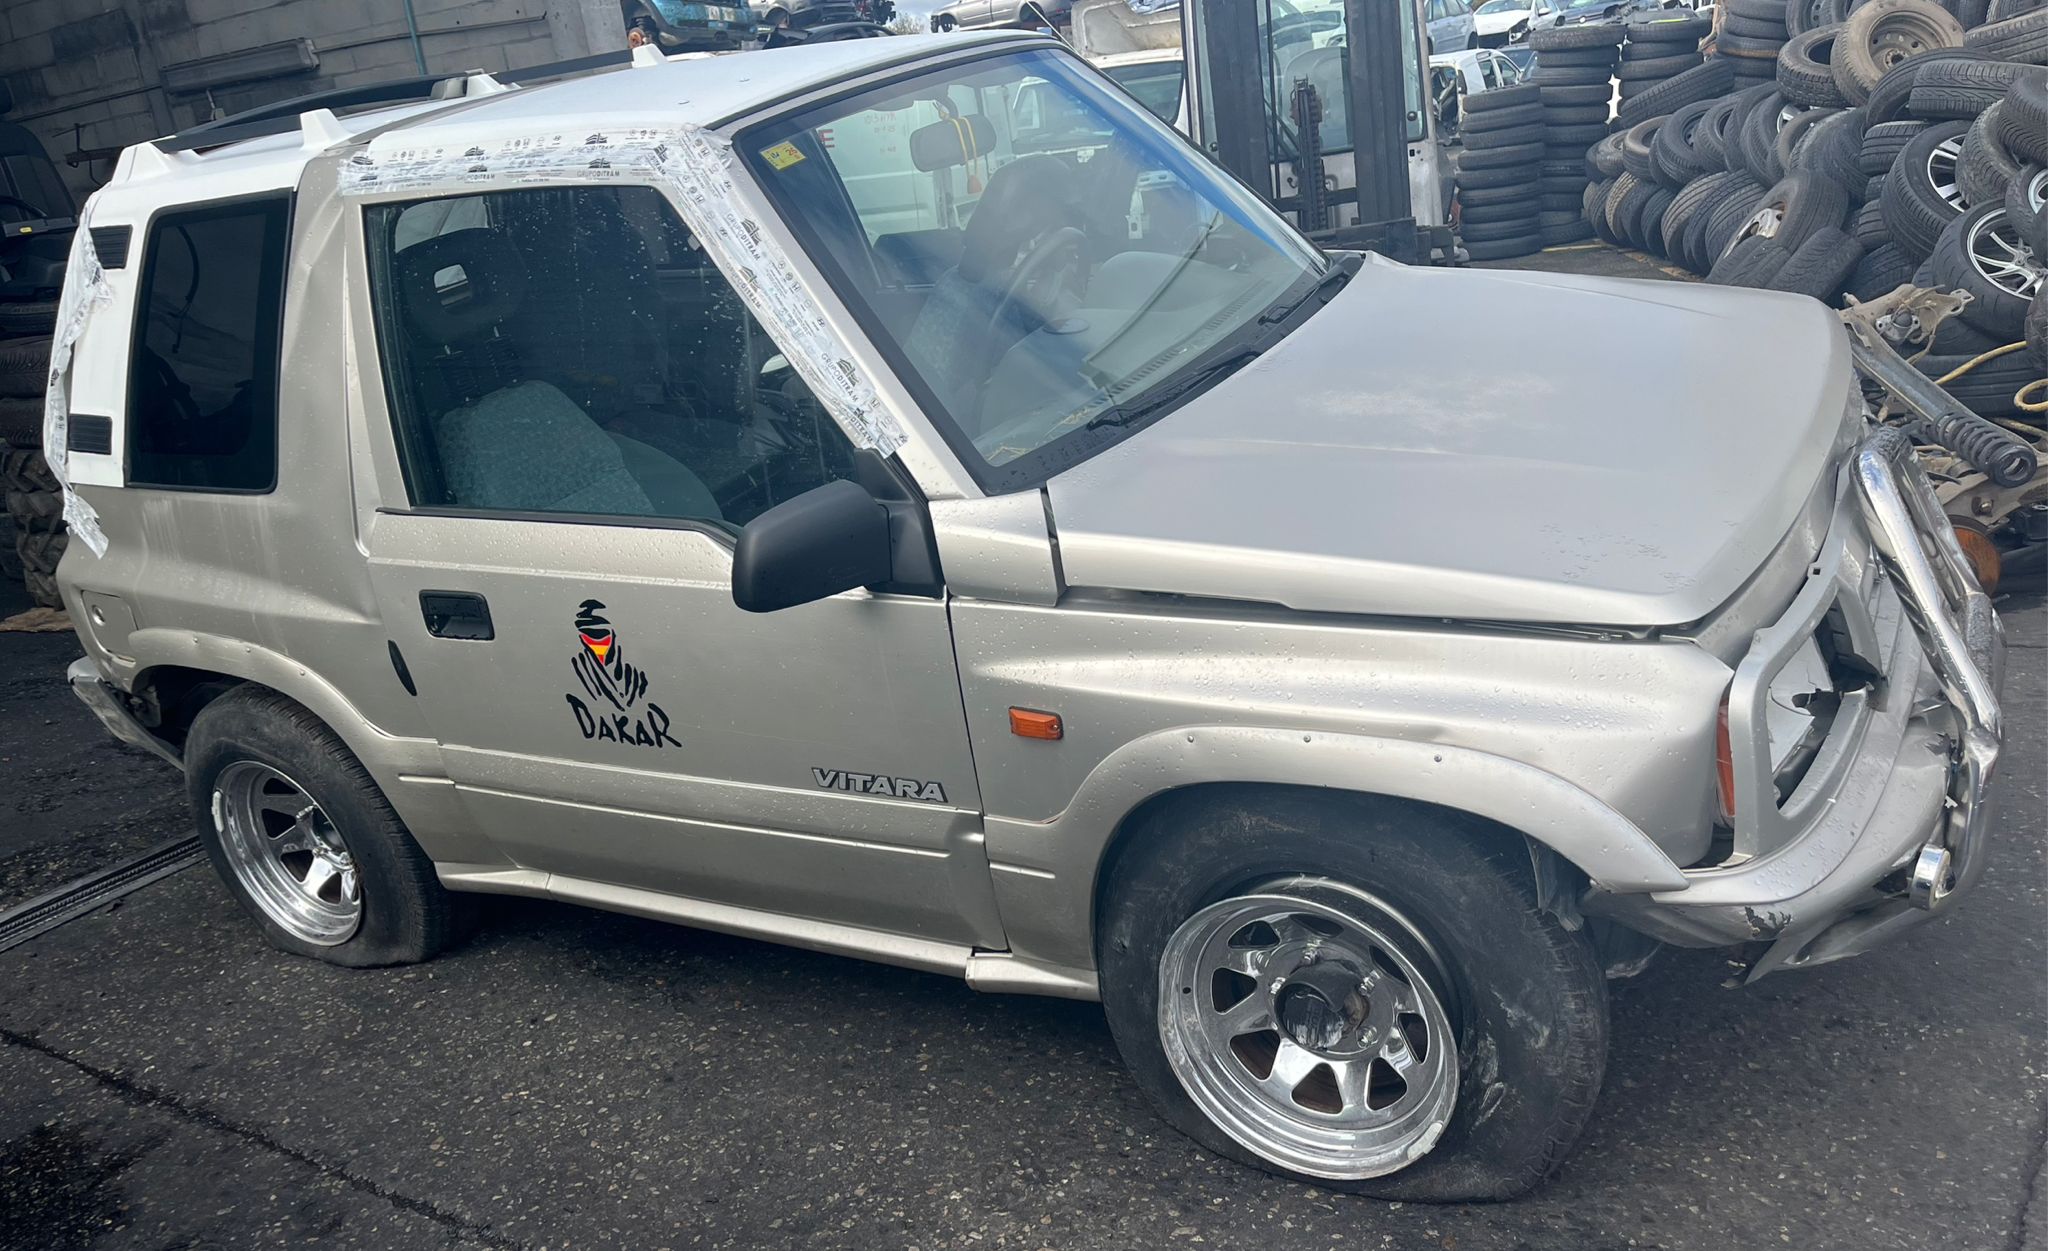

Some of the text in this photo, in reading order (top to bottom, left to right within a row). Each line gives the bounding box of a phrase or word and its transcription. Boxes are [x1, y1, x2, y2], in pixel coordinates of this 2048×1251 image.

[821, 353, 858, 402] GRUPODITRAM
[566, 693, 682, 748] DAKAR
[811, 767, 948, 803] VITARA
